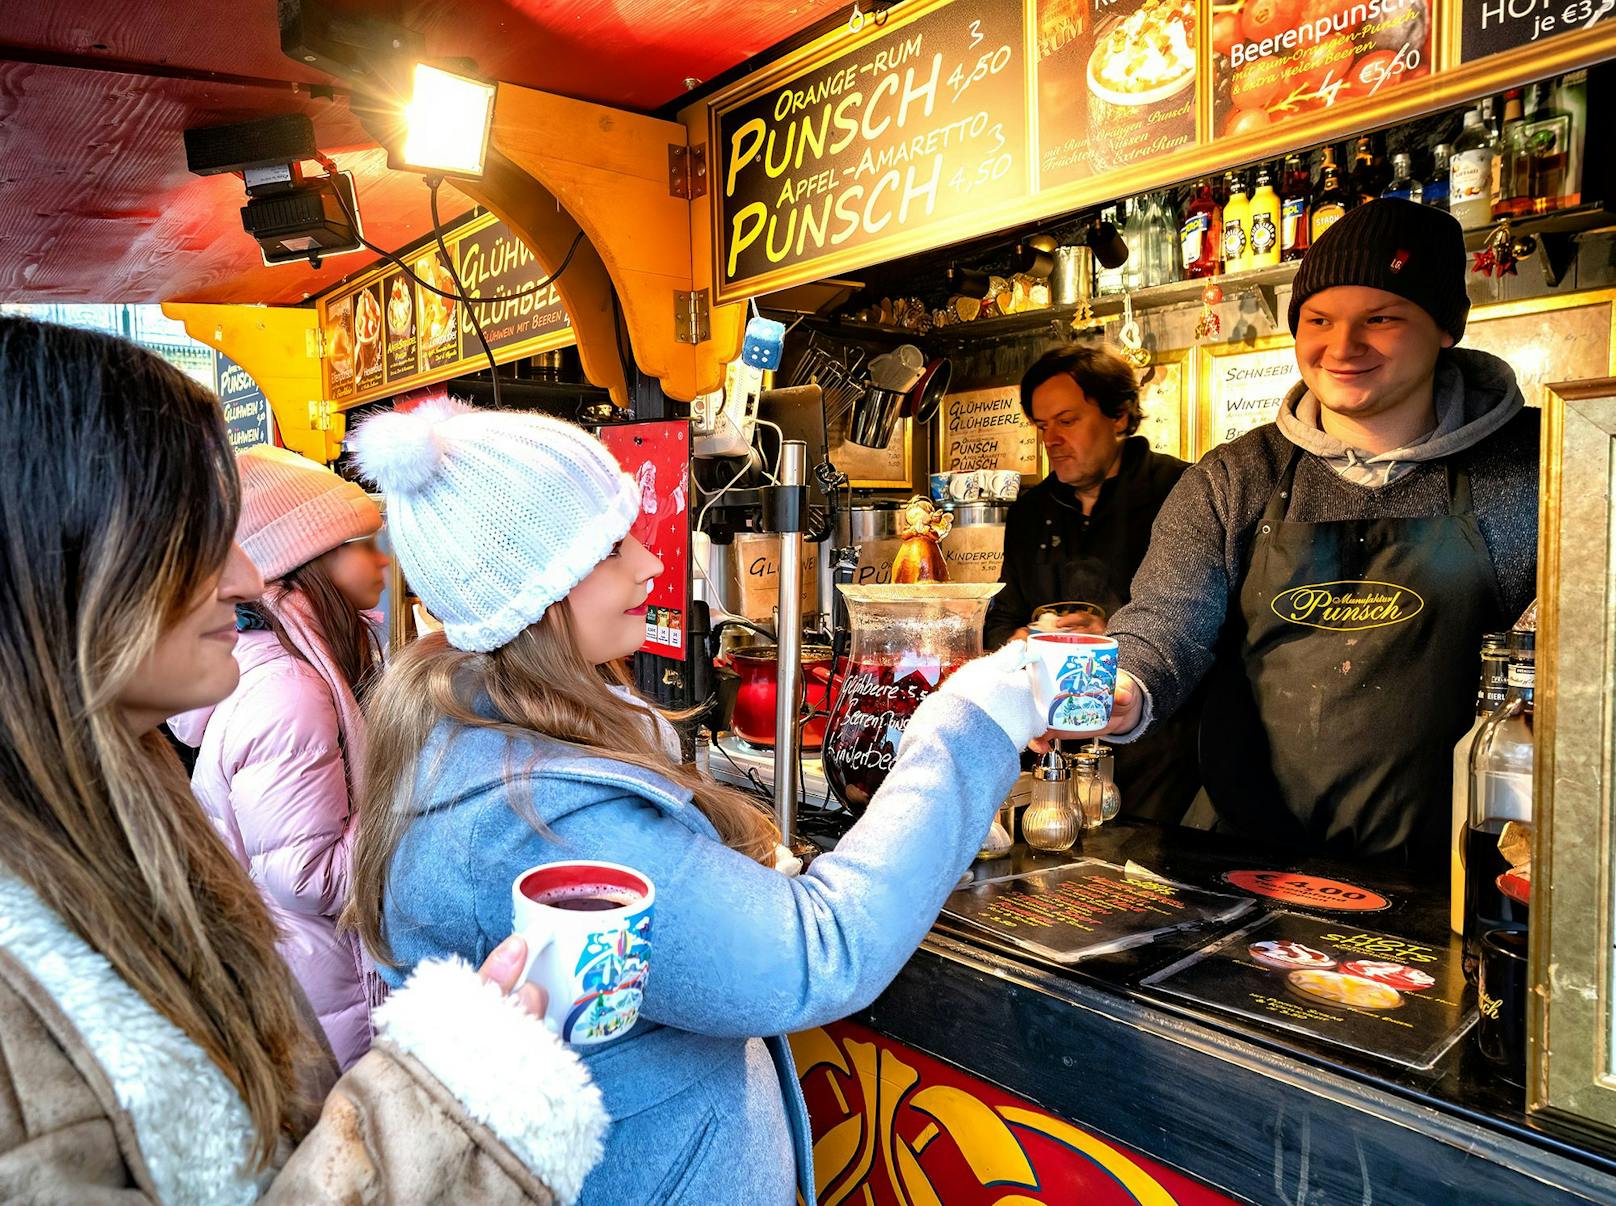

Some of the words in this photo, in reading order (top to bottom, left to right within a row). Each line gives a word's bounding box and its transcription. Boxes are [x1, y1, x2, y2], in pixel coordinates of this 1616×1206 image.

[1531, 15, 1556, 41] je
[1323, 40, 1377, 66] Beeren
[774, 33, 923, 121] ORANGE-RUM
[1232, 65, 1255, 82] mit
[726, 52, 943, 197] PUNSCH
[1148, 101, 1191, 126] Punsch
[726, 153, 944, 278] PUNSCH
[949, 153, 1013, 193] 4,50
[516, 320, 530, 334] MIT
[531, 310, 563, 329] BEEREN
[949, 397, 1013, 418] GLÜHWEIN
[949, 413, 1020, 433] GLÜHBEERE
[950, 440, 998, 457] PUNSCH
[950, 457, 998, 471] PUNSCH
[1290, 588, 1403, 622] Punsch
